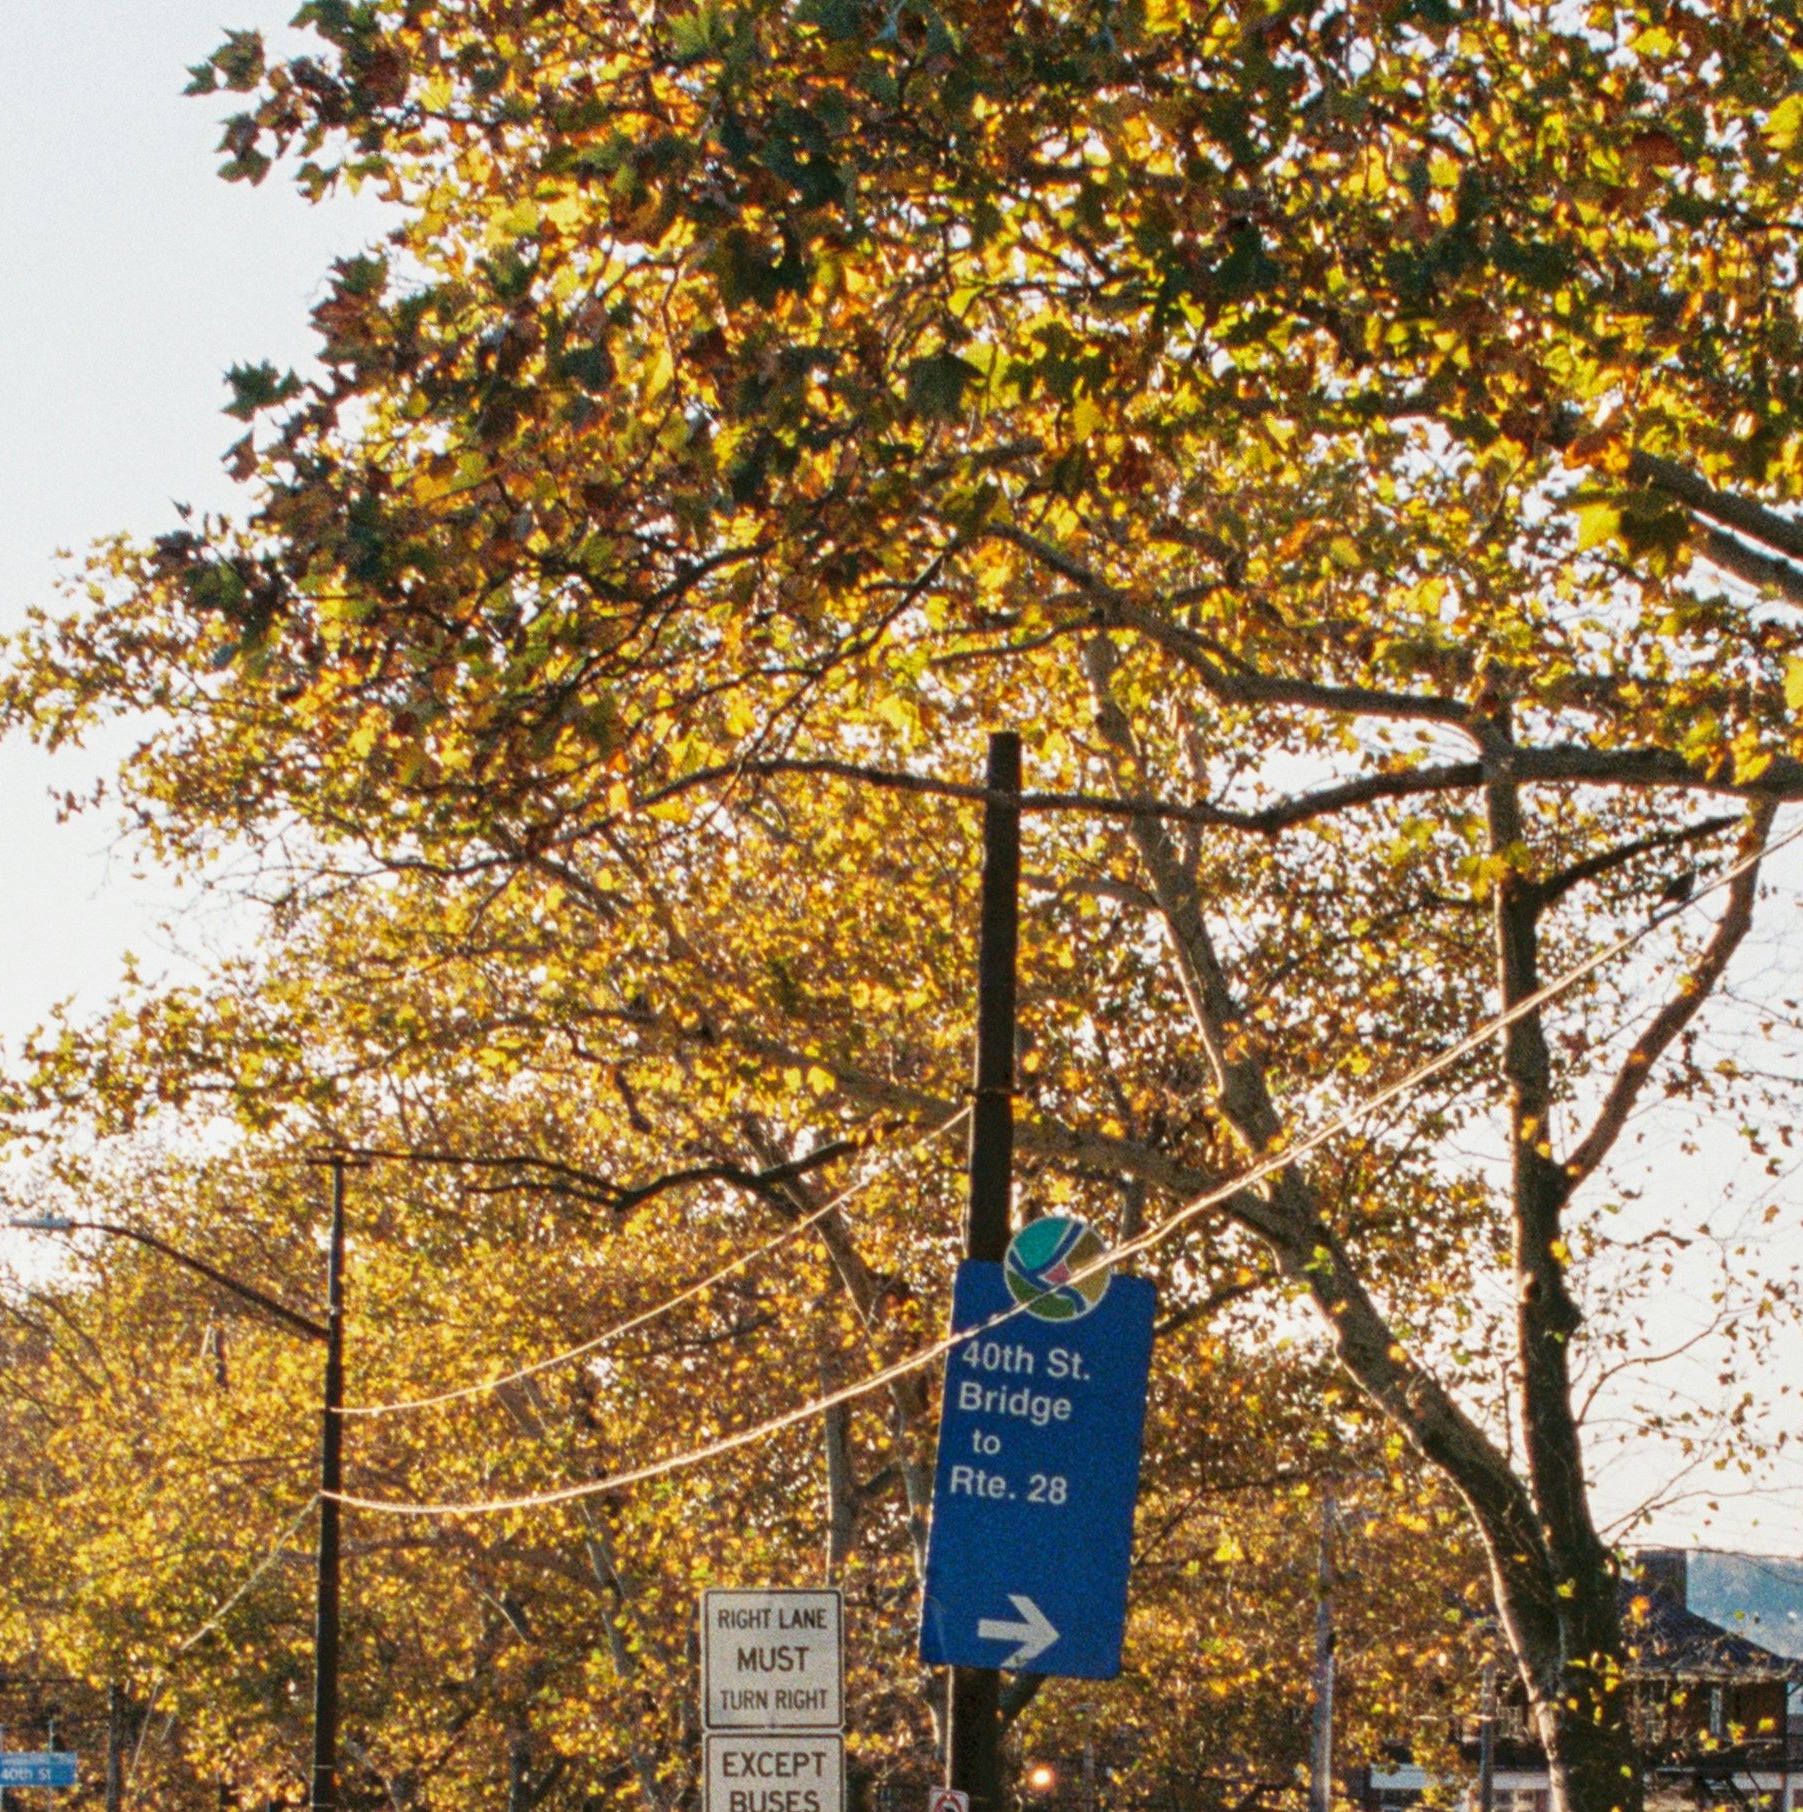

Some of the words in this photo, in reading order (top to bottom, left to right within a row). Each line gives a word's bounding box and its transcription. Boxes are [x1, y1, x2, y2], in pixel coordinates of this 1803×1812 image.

[961, 1340, 1035, 1375] 40th
[1046, 1347, 1091, 1381] St.
[958, 1380, 1073, 1427] Bridge
[972, 1428, 1001, 1456] to
[949, 1464, 1017, 1500] Rte.
[1026, 1473, 1067, 1506] 28
[717, 1608, 772, 1630] RIGHT
[778, 1608, 828, 1630] LANE
[736, 1645, 810, 1673] MUST
[720, 1689, 769, 1711] TURN
[774, 1689, 828, 1711] RIGHT
[0, 1767, 33, 1781] 40th
[721, 1751, 827, 1778] EXCEPT
